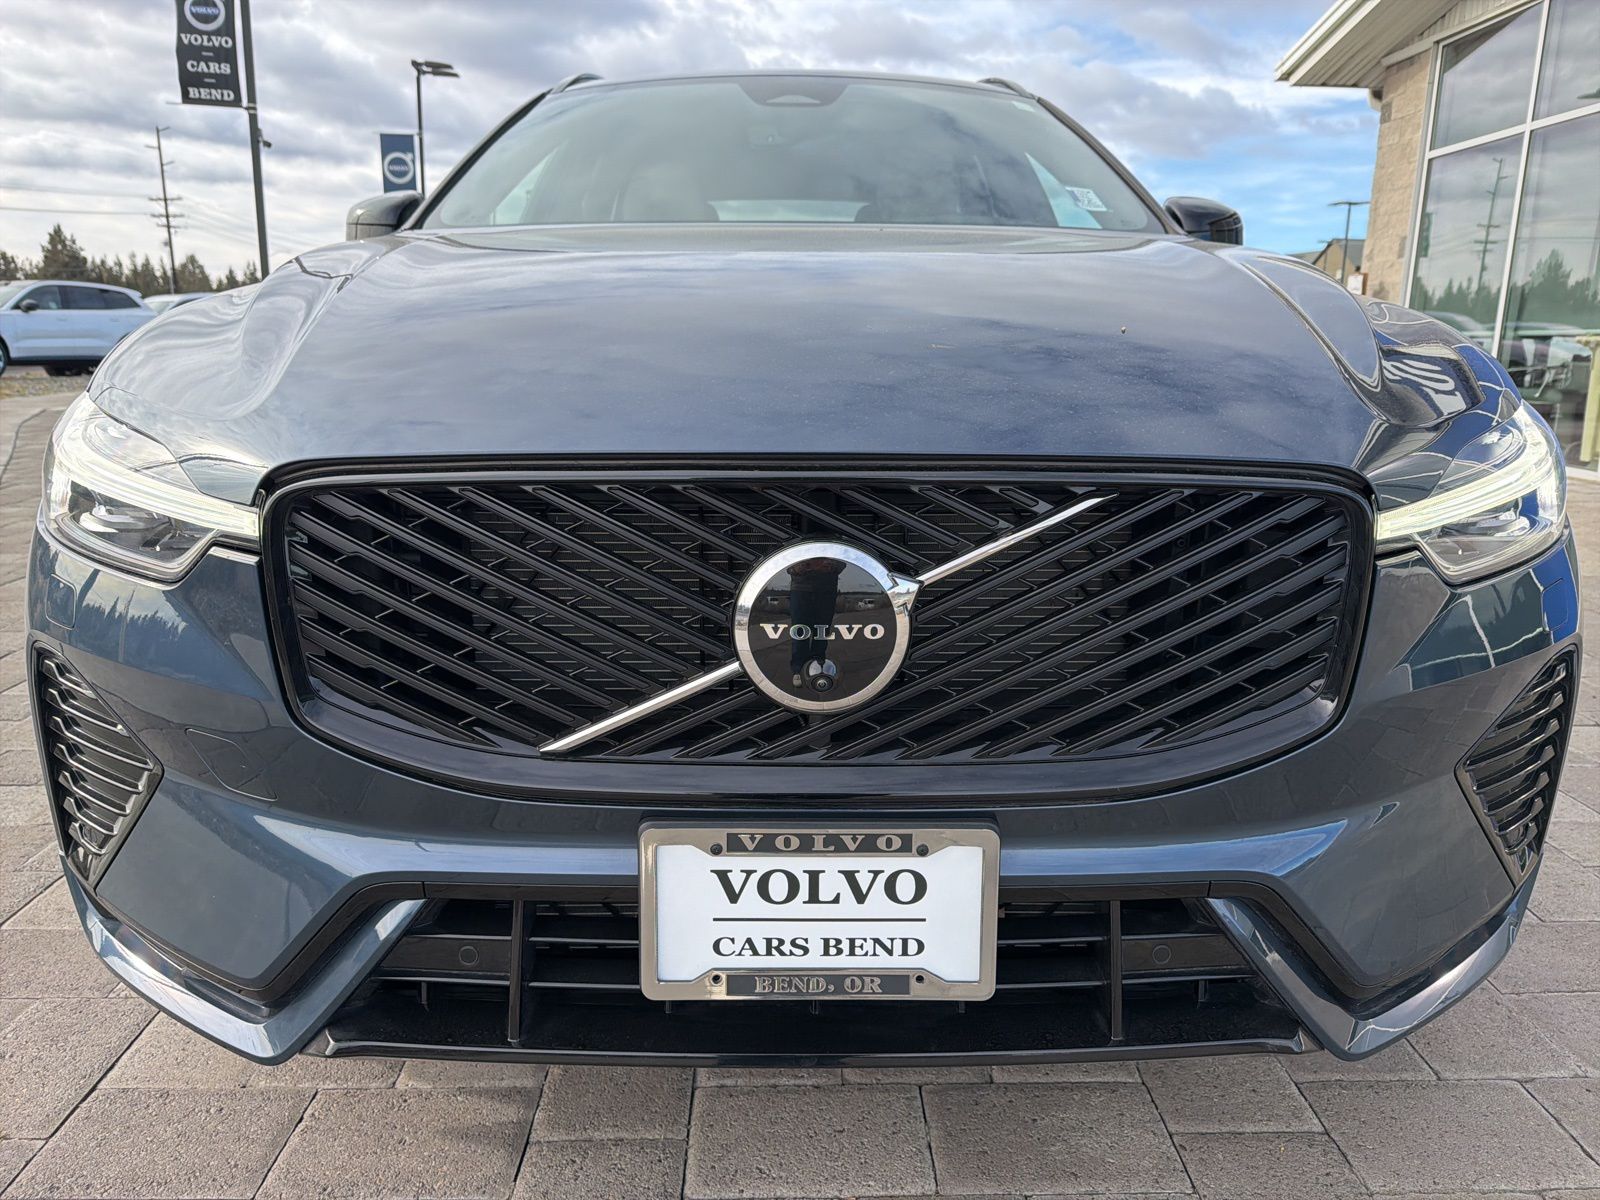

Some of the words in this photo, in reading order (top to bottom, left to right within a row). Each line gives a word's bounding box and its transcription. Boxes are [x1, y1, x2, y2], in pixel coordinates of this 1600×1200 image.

[180, 33, 232, 48] VOLVO
[186, 60, 231, 74] CARS
[187, 87, 235, 101] BEND
[760, 623, 885, 640] VOLVO
[738, 834, 902, 851] VOLVO
[710, 868, 928, 905] VOLVO
[712, 937, 810, 957] CARS
[820, 937, 925, 957] BEND
[754, 976, 835, 993] BEND,
[844, 976, 882, 993] OR
